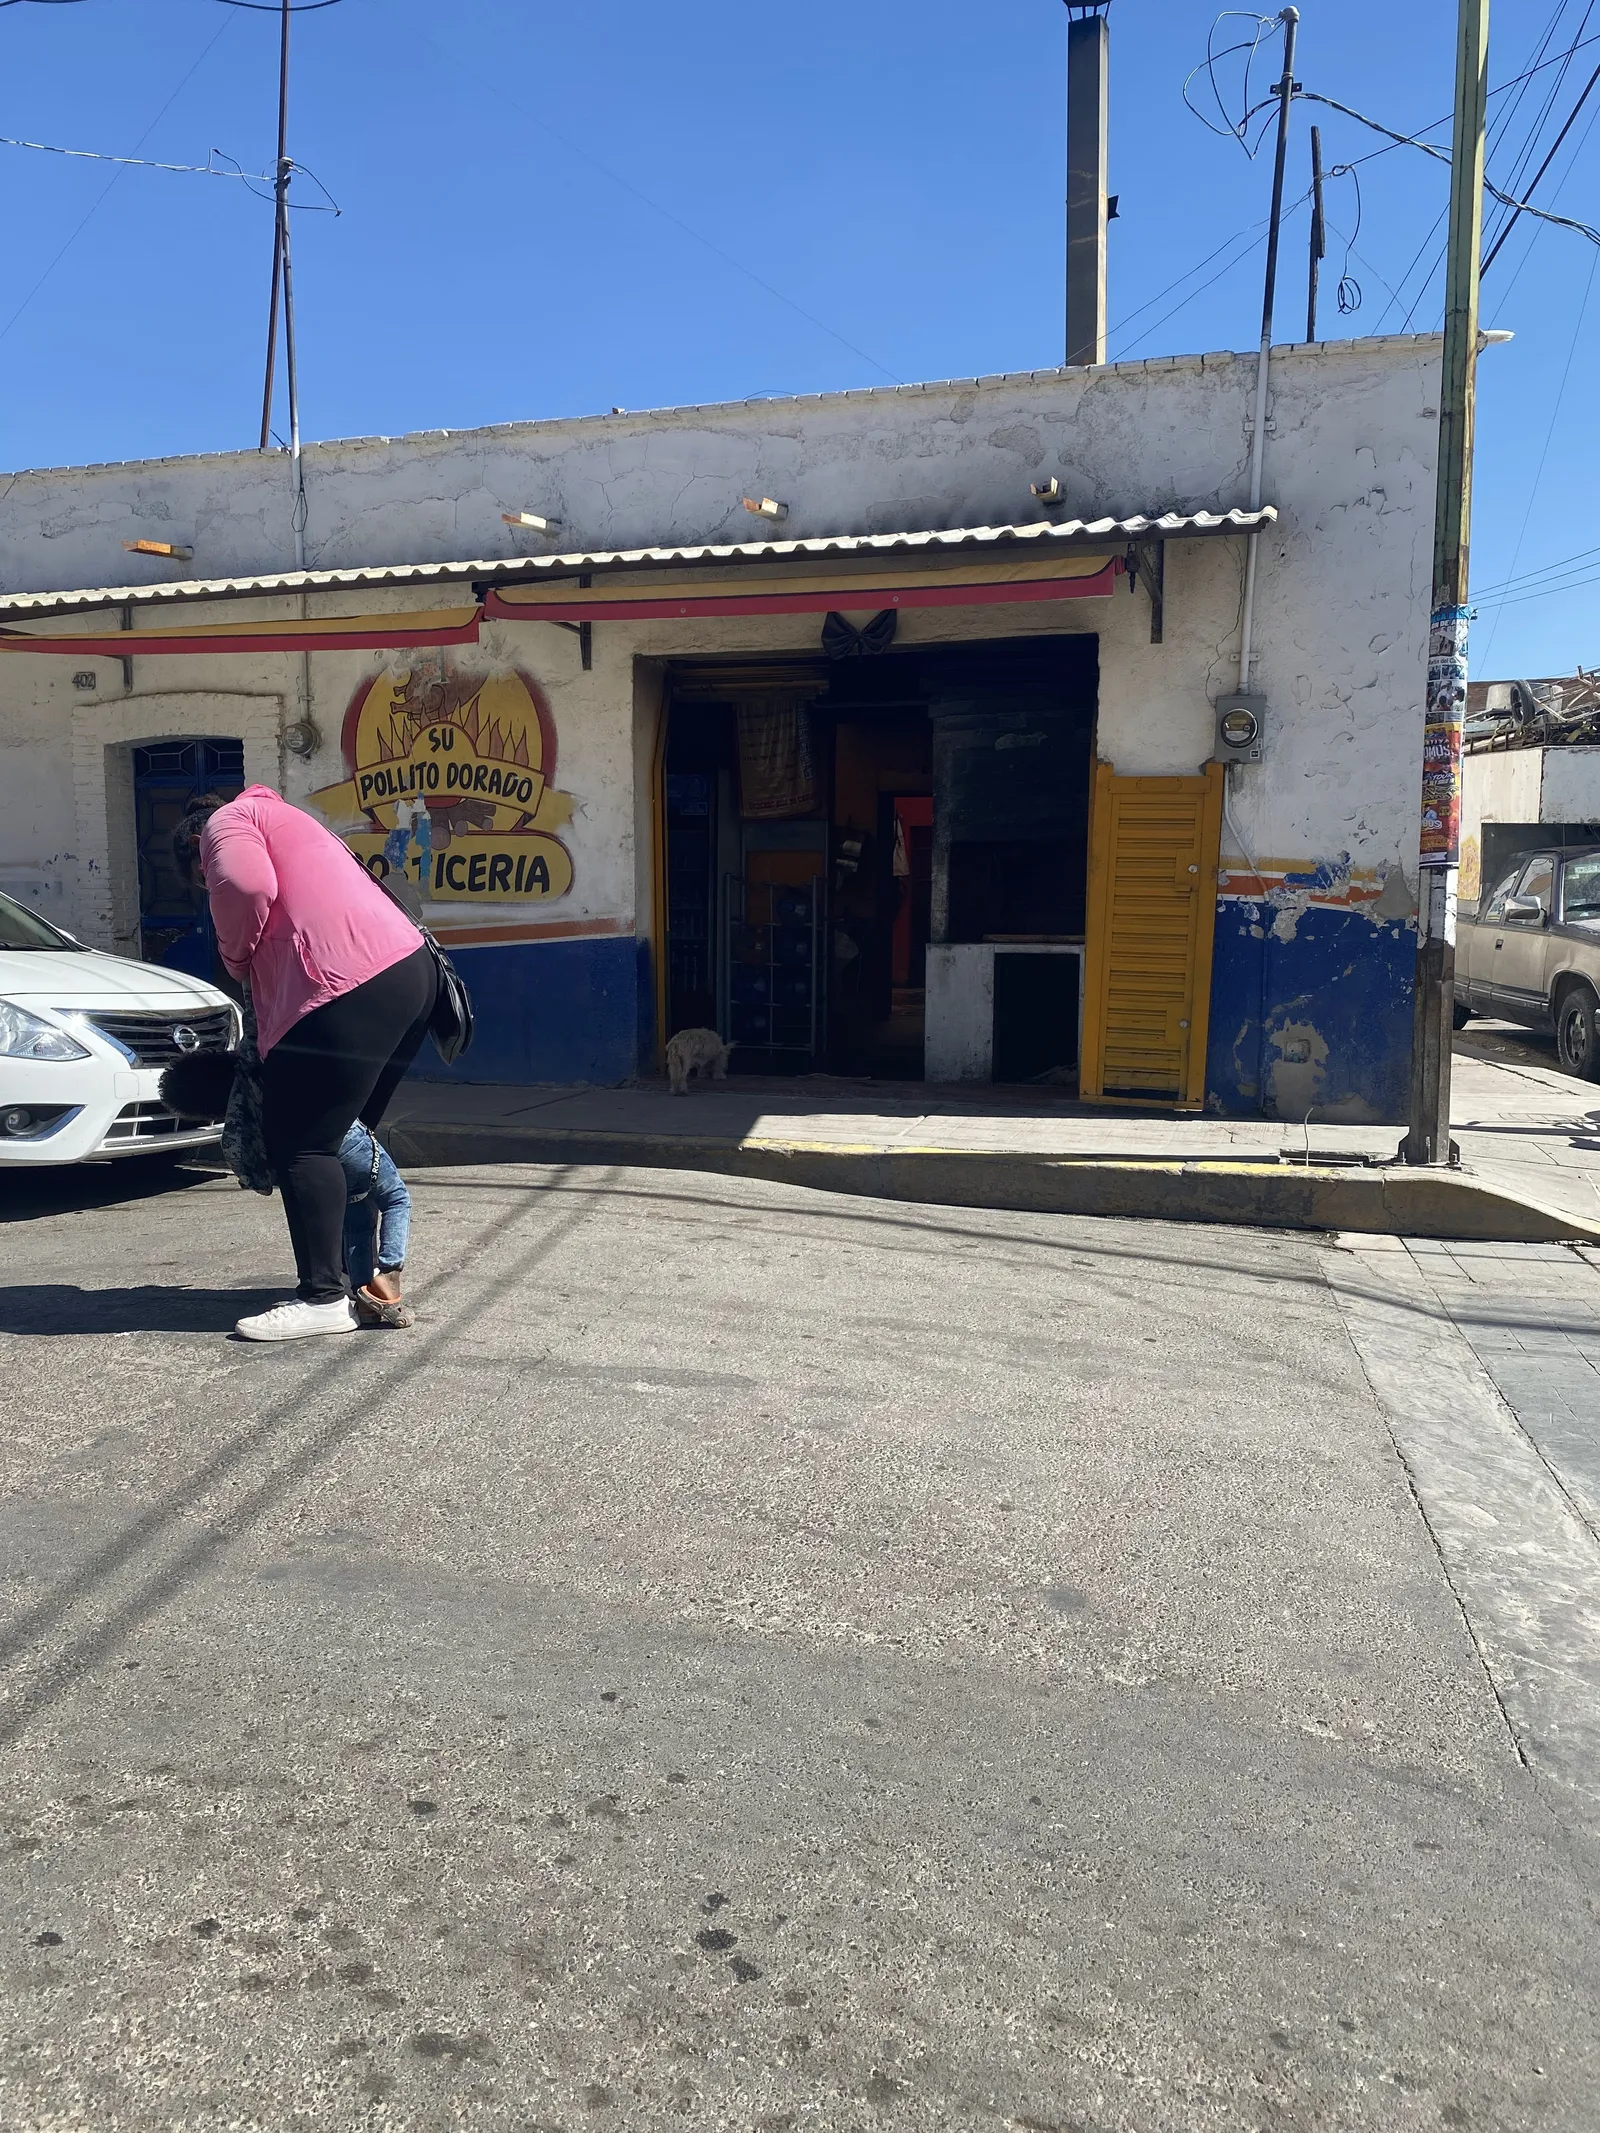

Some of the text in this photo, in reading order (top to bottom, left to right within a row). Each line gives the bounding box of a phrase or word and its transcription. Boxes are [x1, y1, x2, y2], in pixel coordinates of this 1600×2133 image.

[71, 673, 95, 688] 402
[428, 726, 454, 752] SU
[360, 761, 533, 803] POLLITO DORADO
